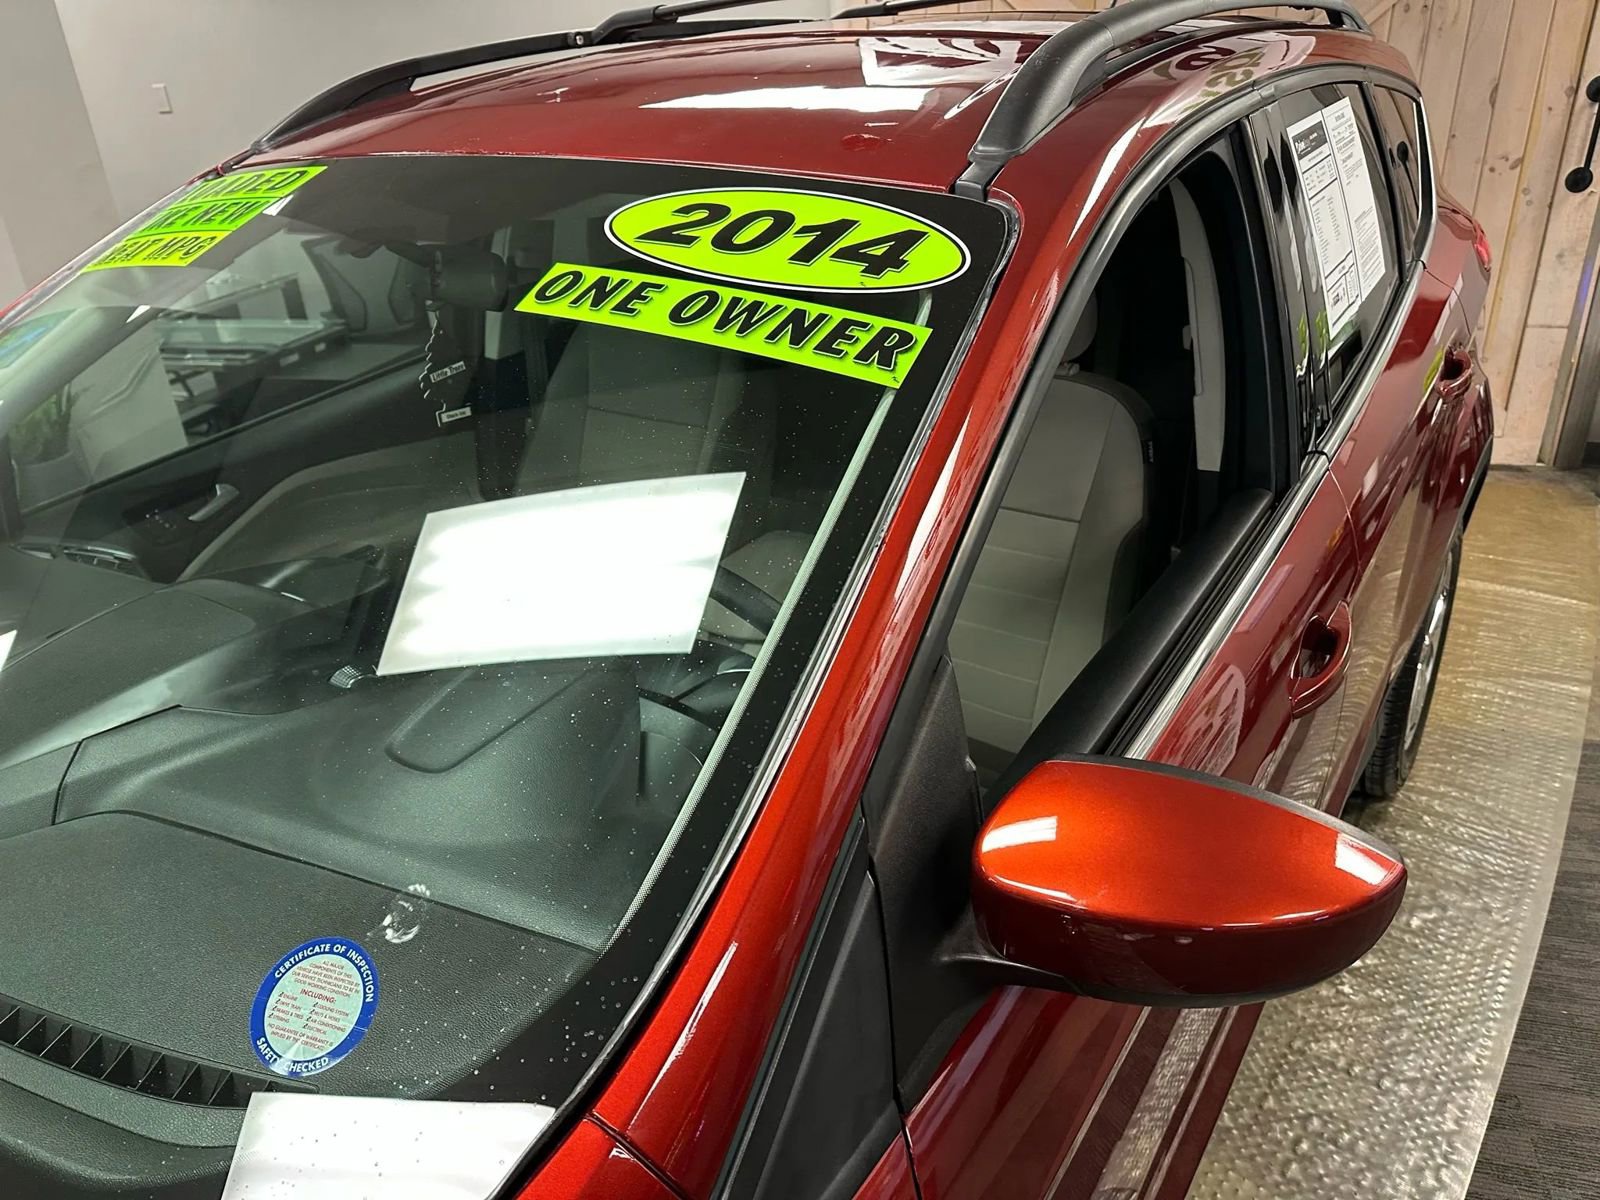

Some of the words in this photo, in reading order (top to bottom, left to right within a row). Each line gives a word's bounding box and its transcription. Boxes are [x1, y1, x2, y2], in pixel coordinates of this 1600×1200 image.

[182, 200, 271, 226] NEW
[141, 236, 218, 260] MPG
[634, 203, 933, 279] 2014
[533, 270, 668, 316] ONE
[668, 290, 917, 374] OWNER
[274, 943, 331, 978] CERTIFICATE
[333, 944, 347, 954] OF
[346, 948, 374, 1003] INSPECTION
[299, 988, 336, 1003] INCLUDING:
[256, 1037, 281, 1064] SAFETY
[284, 1056, 329, 1073] CHECKED
